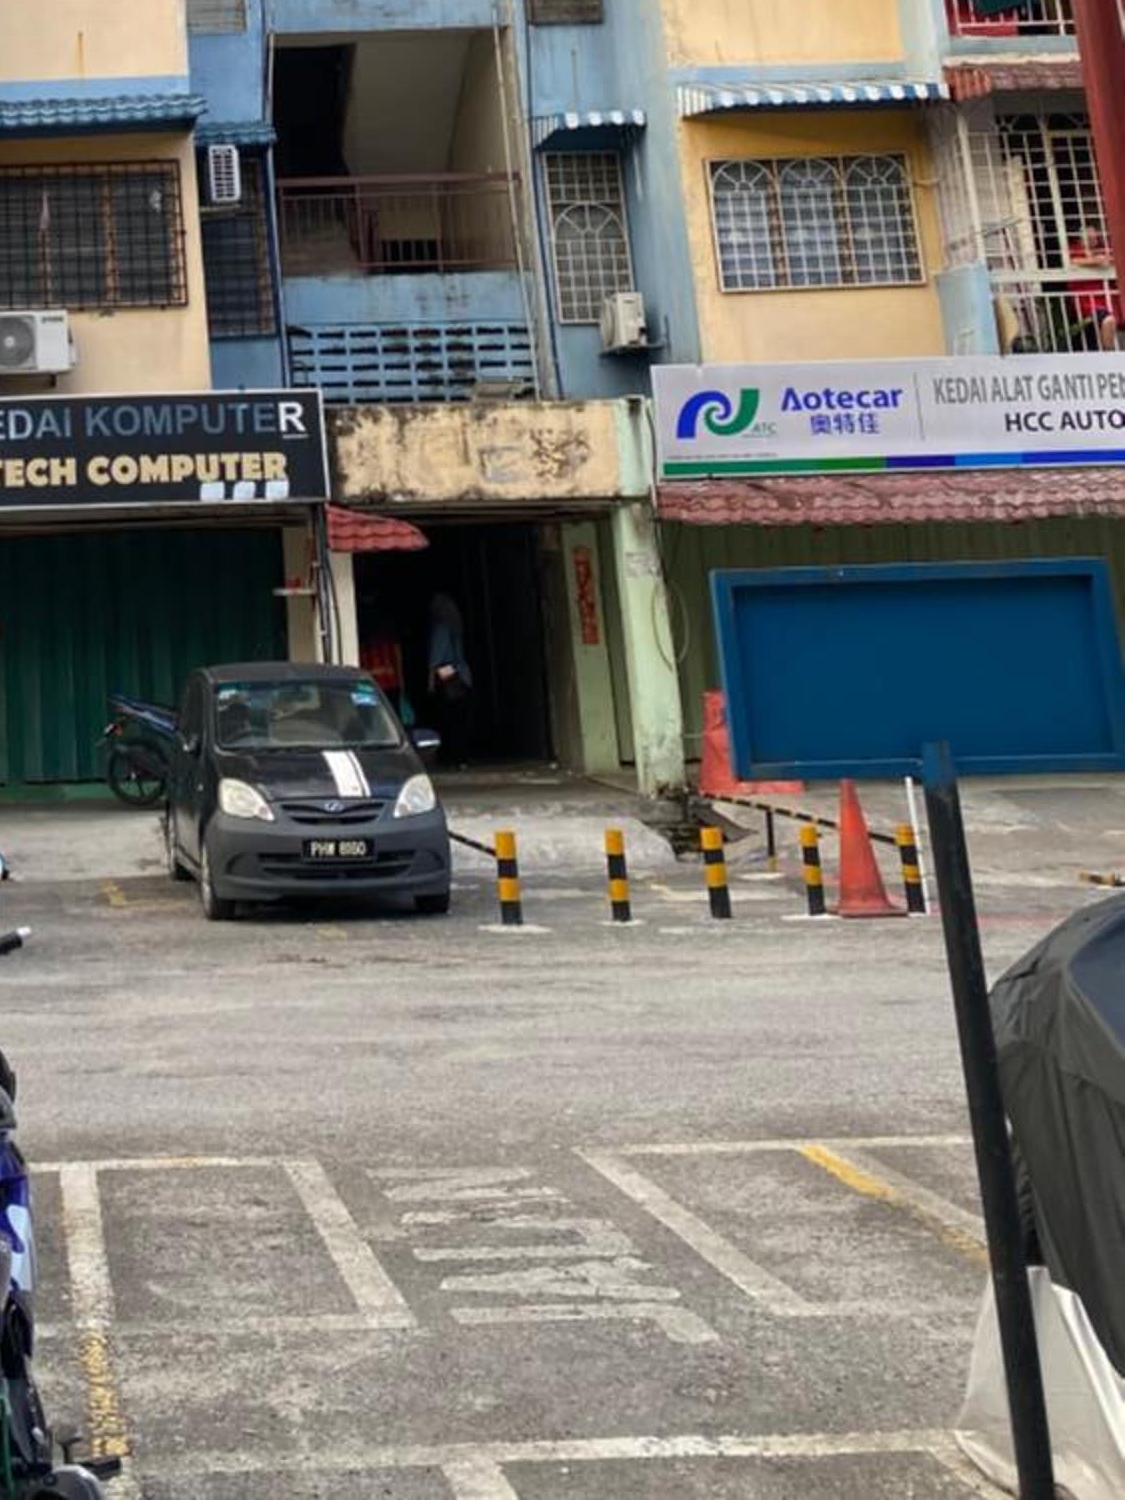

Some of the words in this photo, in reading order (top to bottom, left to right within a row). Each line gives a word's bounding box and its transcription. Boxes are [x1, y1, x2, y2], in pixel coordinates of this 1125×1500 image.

[781, 387, 904, 412] Aotecar
[933, 376, 987, 405] KEDAI
[991, 375, 1033, 402] ALAT
[1038, 372, 1093, 401] GANTI
[84, 401, 307, 437] KOMPUTER
[1005, 410, 1054, 432] HCC
[87, 451, 288, 485] COMPUTER
